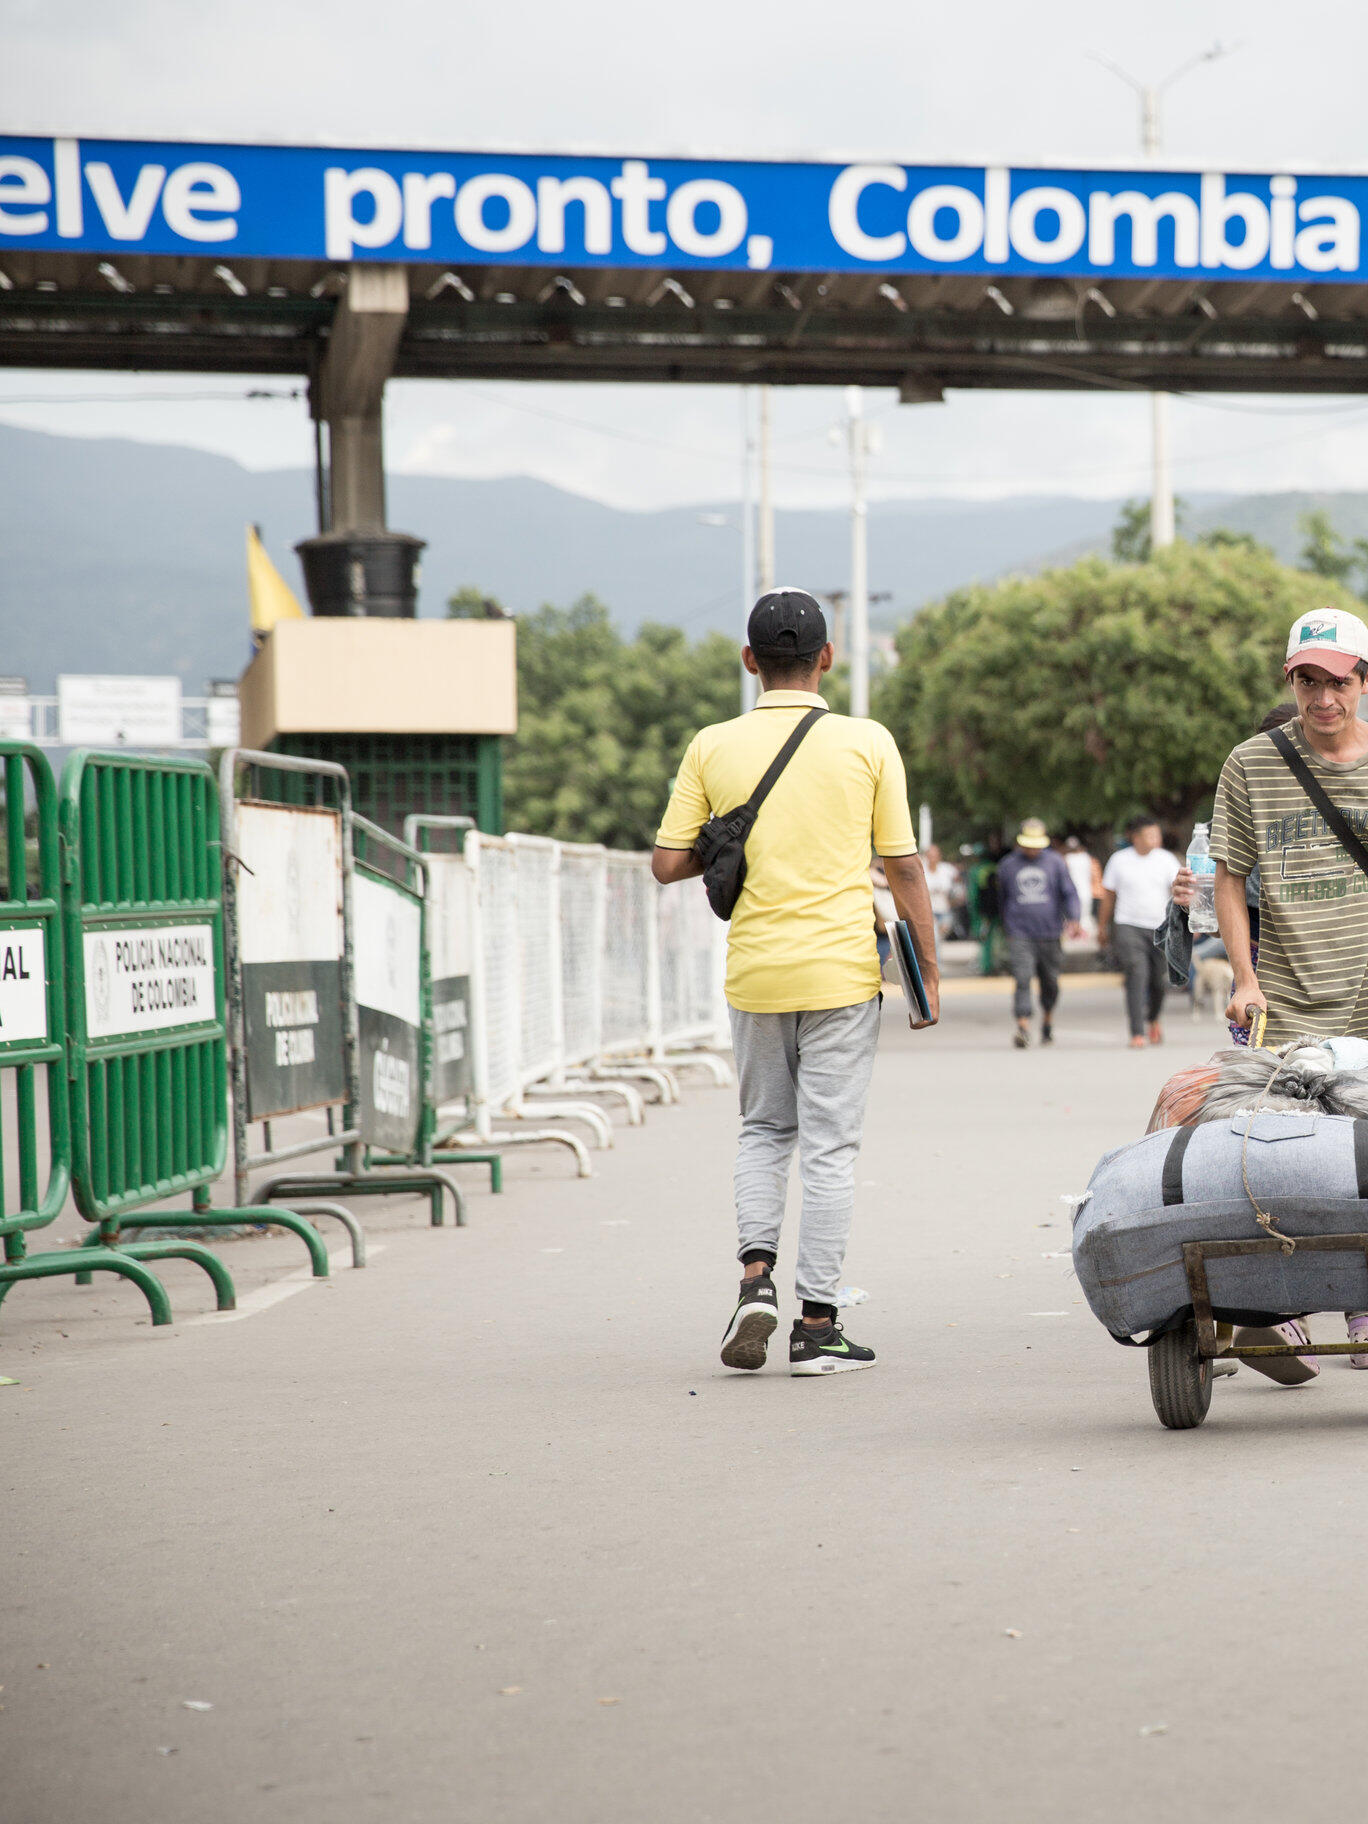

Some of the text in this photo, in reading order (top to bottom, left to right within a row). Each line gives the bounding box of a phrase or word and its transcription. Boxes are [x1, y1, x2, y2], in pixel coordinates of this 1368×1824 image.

[0, 138, 242, 243] elve
[325, 162, 772, 270] pronto,
[829, 165, 1361, 273] Colombia
[116, 937, 206, 973] POLICIA NACIONAL
[132, 978, 197, 1013] DE COLOMBIA
[758, 1288, 773, 1296] NIKE
